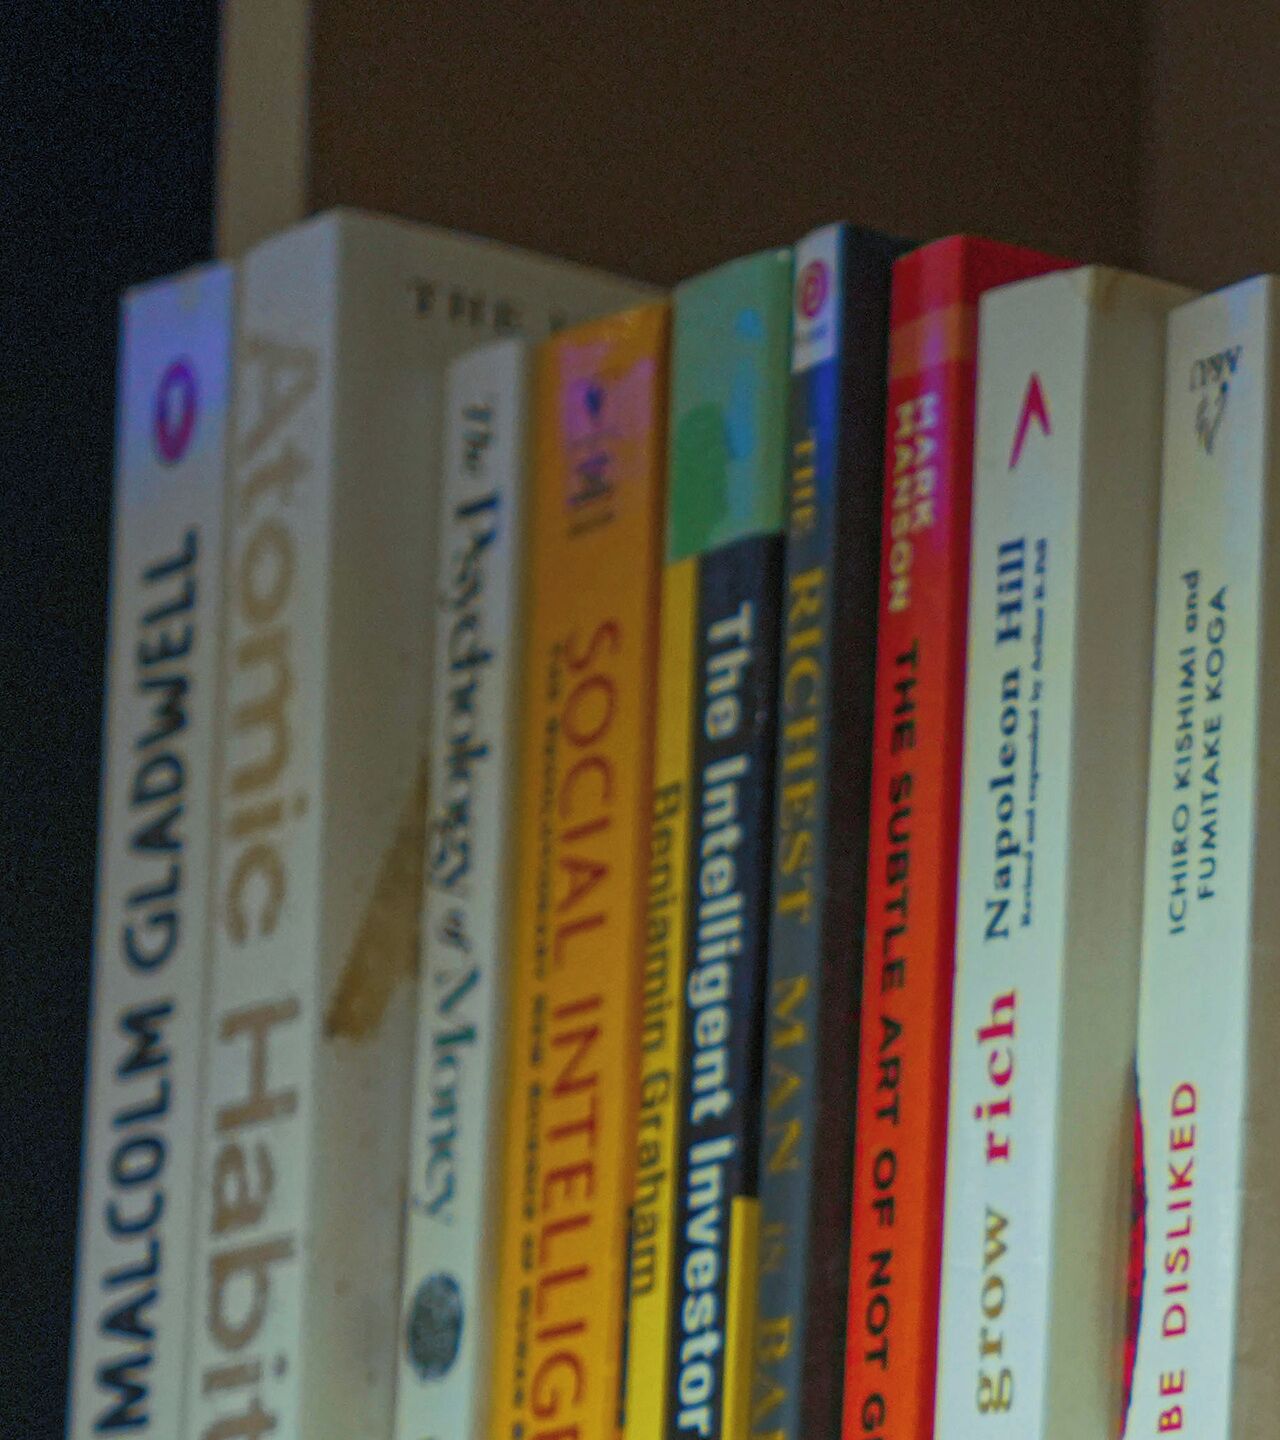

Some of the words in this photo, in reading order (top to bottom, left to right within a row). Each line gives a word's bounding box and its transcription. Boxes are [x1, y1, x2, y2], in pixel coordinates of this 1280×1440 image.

[791, 430, 819, 536] THE
[889, 402, 916, 613] MANSON
[906, 392, 935, 525] MARK
[224, 331, 323, 948] Atomic
[703, 602, 756, 739] The
[995, 539, 1024, 643] Hill
[1182, 569, 1201, 635] and
[1204, 585, 1229, 706] KOGA
[122, 527, 200, 971] GLADWELL
[429, 493, 503, 901] Psychology
[772, 567, 827, 923] RICHEST
[888, 637, 920, 755] THE
[1027, 709, 1044, 801] expanded
[1174, 647, 1196, 788] KISHIMI
[551, 619, 624, 968] SOCIAL
[880, 771, 914, 996] SUBTLE
[985, 669, 1022, 940] Napoleon
[1024, 809, 1038, 843] and
[1168, 801, 1192, 936] ICHIRO
[1196, 716, 1222, 901] FUMITAKE
[641, 782, 682, 1050] Benjamin
[685, 758, 748, 1125] Intelligent
[411, 968, 482, 1225] Money
[764, 978, 813, 1175] MAN
[873, 1018, 905, 1125] ART
[975, 989, 1018, 1164] rich
[94, 1002, 174, 1437] MALCOLM
[632, 1071, 674, 1298] Graham
[870, 1150, 898, 1226] OF
[1163, 1081, 1199, 1339] DISLIKED
[676, 1138, 734, 1437] Investor
[862, 1251, 893, 1370] NOT
[977, 1210, 1012, 1412] grow
[1156, 1368, 1185, 1434] BE
